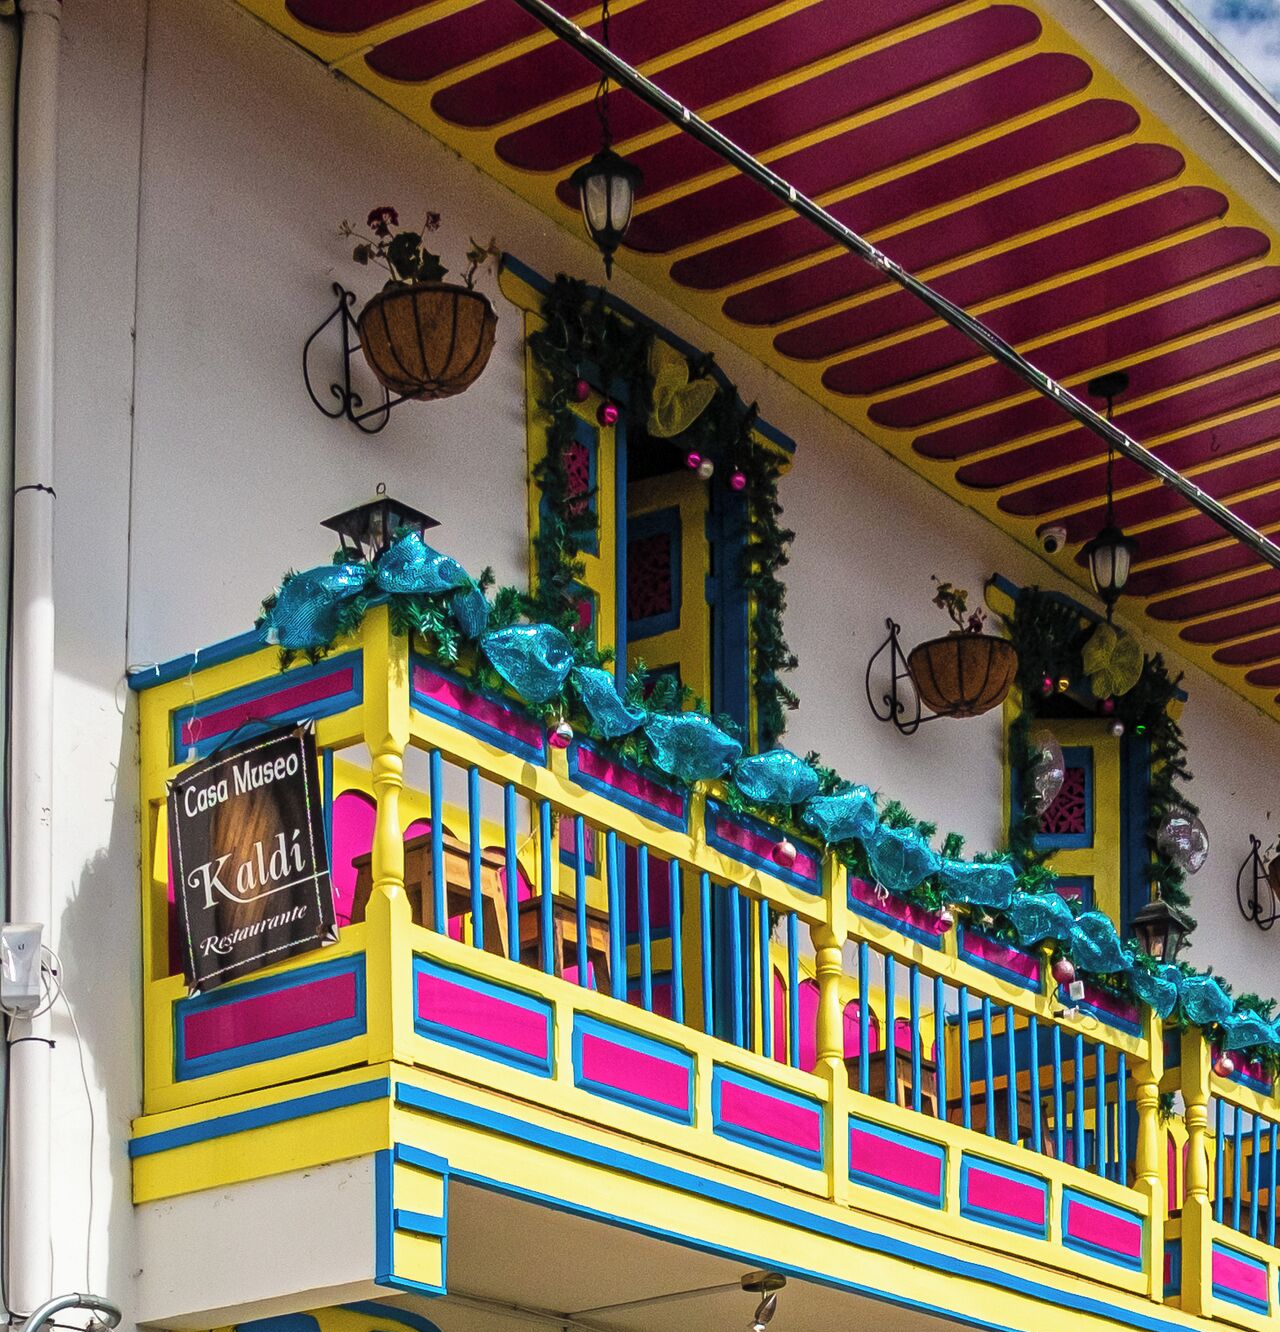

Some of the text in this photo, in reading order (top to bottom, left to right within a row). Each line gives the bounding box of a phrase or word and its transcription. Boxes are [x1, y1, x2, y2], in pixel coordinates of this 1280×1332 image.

[184, 752, 299, 819] Casa Museo
[200, 905, 308, 957] Restaurante
